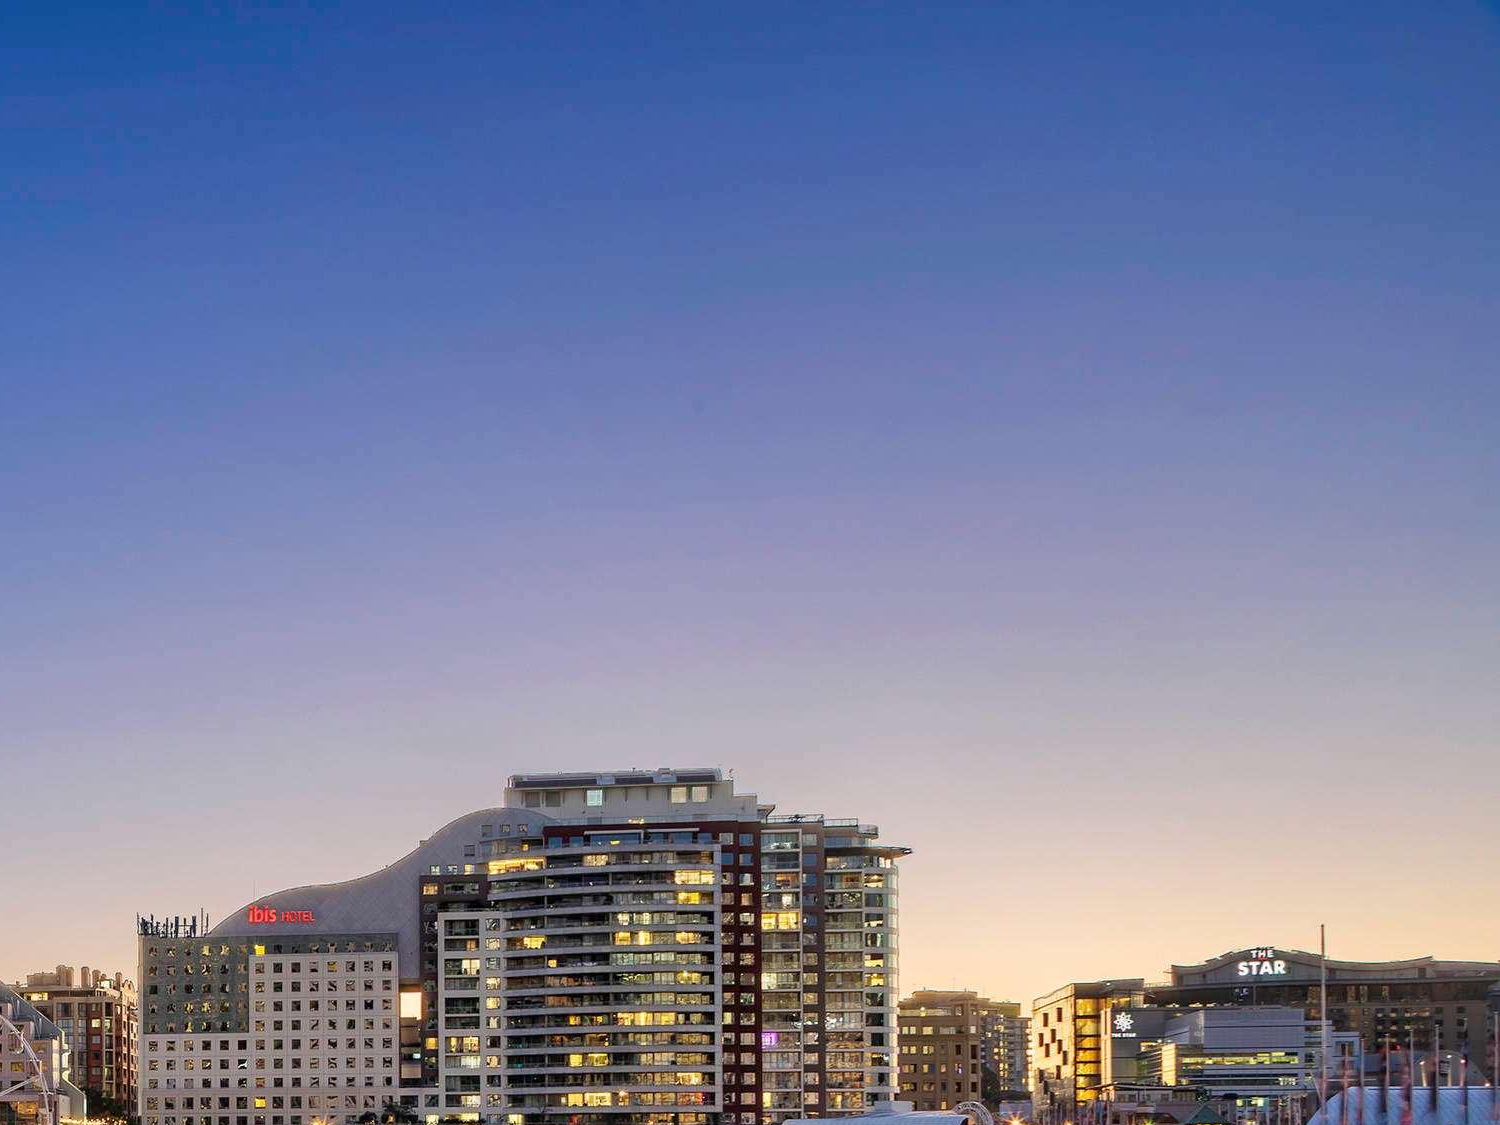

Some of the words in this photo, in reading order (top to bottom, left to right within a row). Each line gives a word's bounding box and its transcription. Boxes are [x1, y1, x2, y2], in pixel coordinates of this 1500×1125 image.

[247, 904, 277, 923] ibis
[281, 910, 316, 923] HOTEL
[1250, 949, 1275, 959] THE
[1237, 960, 1287, 976] STAR
